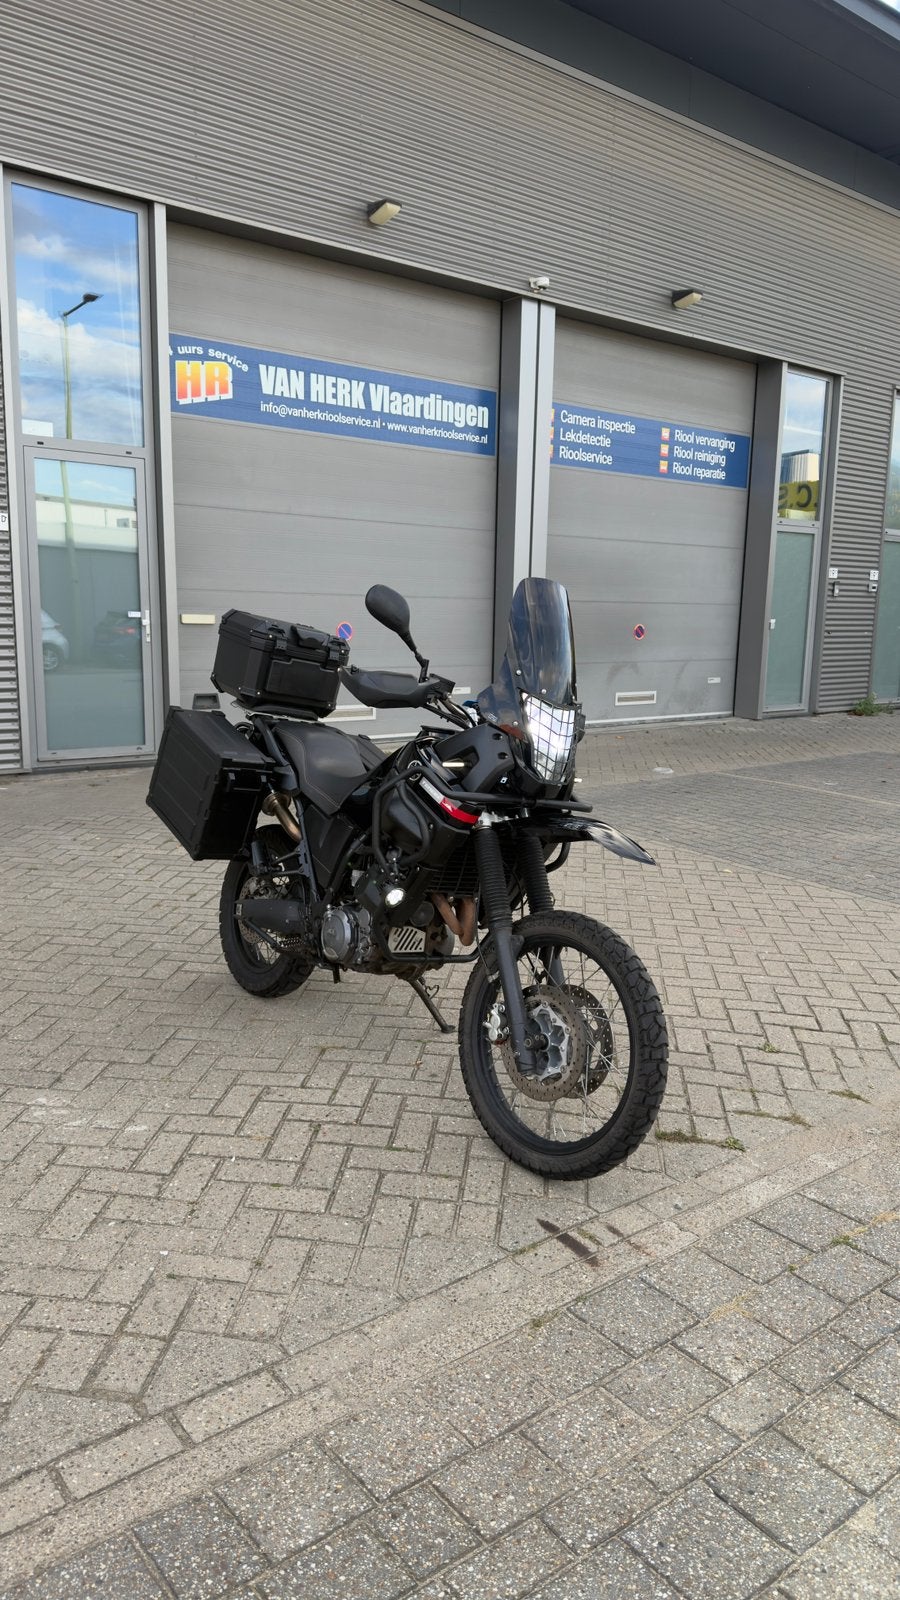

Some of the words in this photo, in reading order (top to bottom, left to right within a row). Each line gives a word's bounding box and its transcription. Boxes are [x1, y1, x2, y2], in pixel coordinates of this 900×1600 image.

[177, 345, 204, 355] uurs
[208, 348, 249, 372] service
[175, 360, 233, 405] HR
[258, 363, 305, 400] VAN
[310, 372, 366, 410] HERK
[368, 382, 489, 429] Vlaardingen
[260, 400, 381, 430] info@vanherkrioolservice.nl
[387, 420, 488, 444] www.vanherkrioolservice.nl
[560, 409, 596, 428] Camera
[597, 415, 636, 434] inspectie
[560, 427, 611, 448] Lekdetectie
[674, 429, 695, 444] Riool
[695, 435, 736, 453] vervanging
[559, 445, 613, 465] Rioolservice
[673, 445, 694, 460] Riool
[694, 449, 726, 467] reiniging
[672, 461, 693, 476] Riool
[693, 467, 726, 480] reparatie
